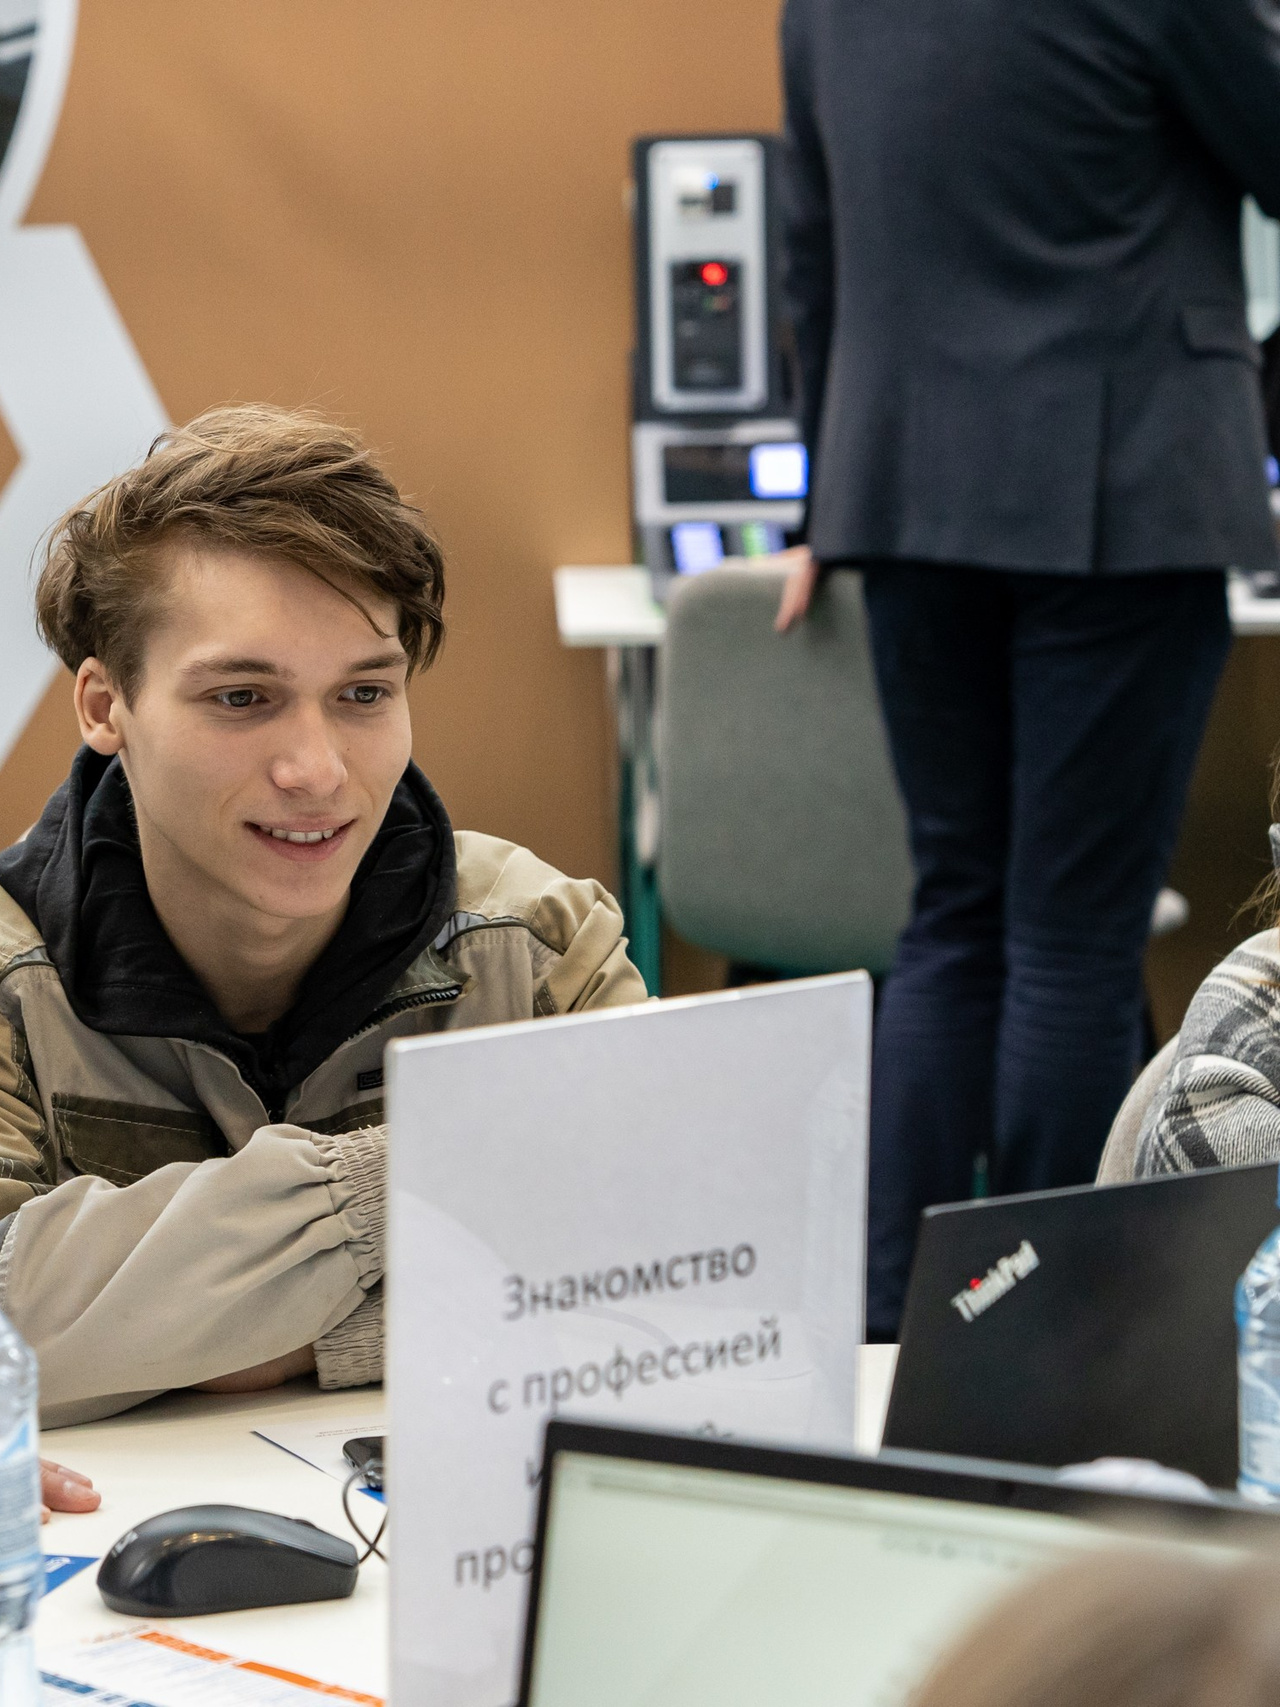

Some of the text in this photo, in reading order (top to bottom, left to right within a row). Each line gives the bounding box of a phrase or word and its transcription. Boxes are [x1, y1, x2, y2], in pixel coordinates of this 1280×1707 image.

[501, 1241, 758, 1322] Знакомство
[949, 1239, 1040, 1323] ThinkPad
[523, 1316, 783, 1411] профессией
